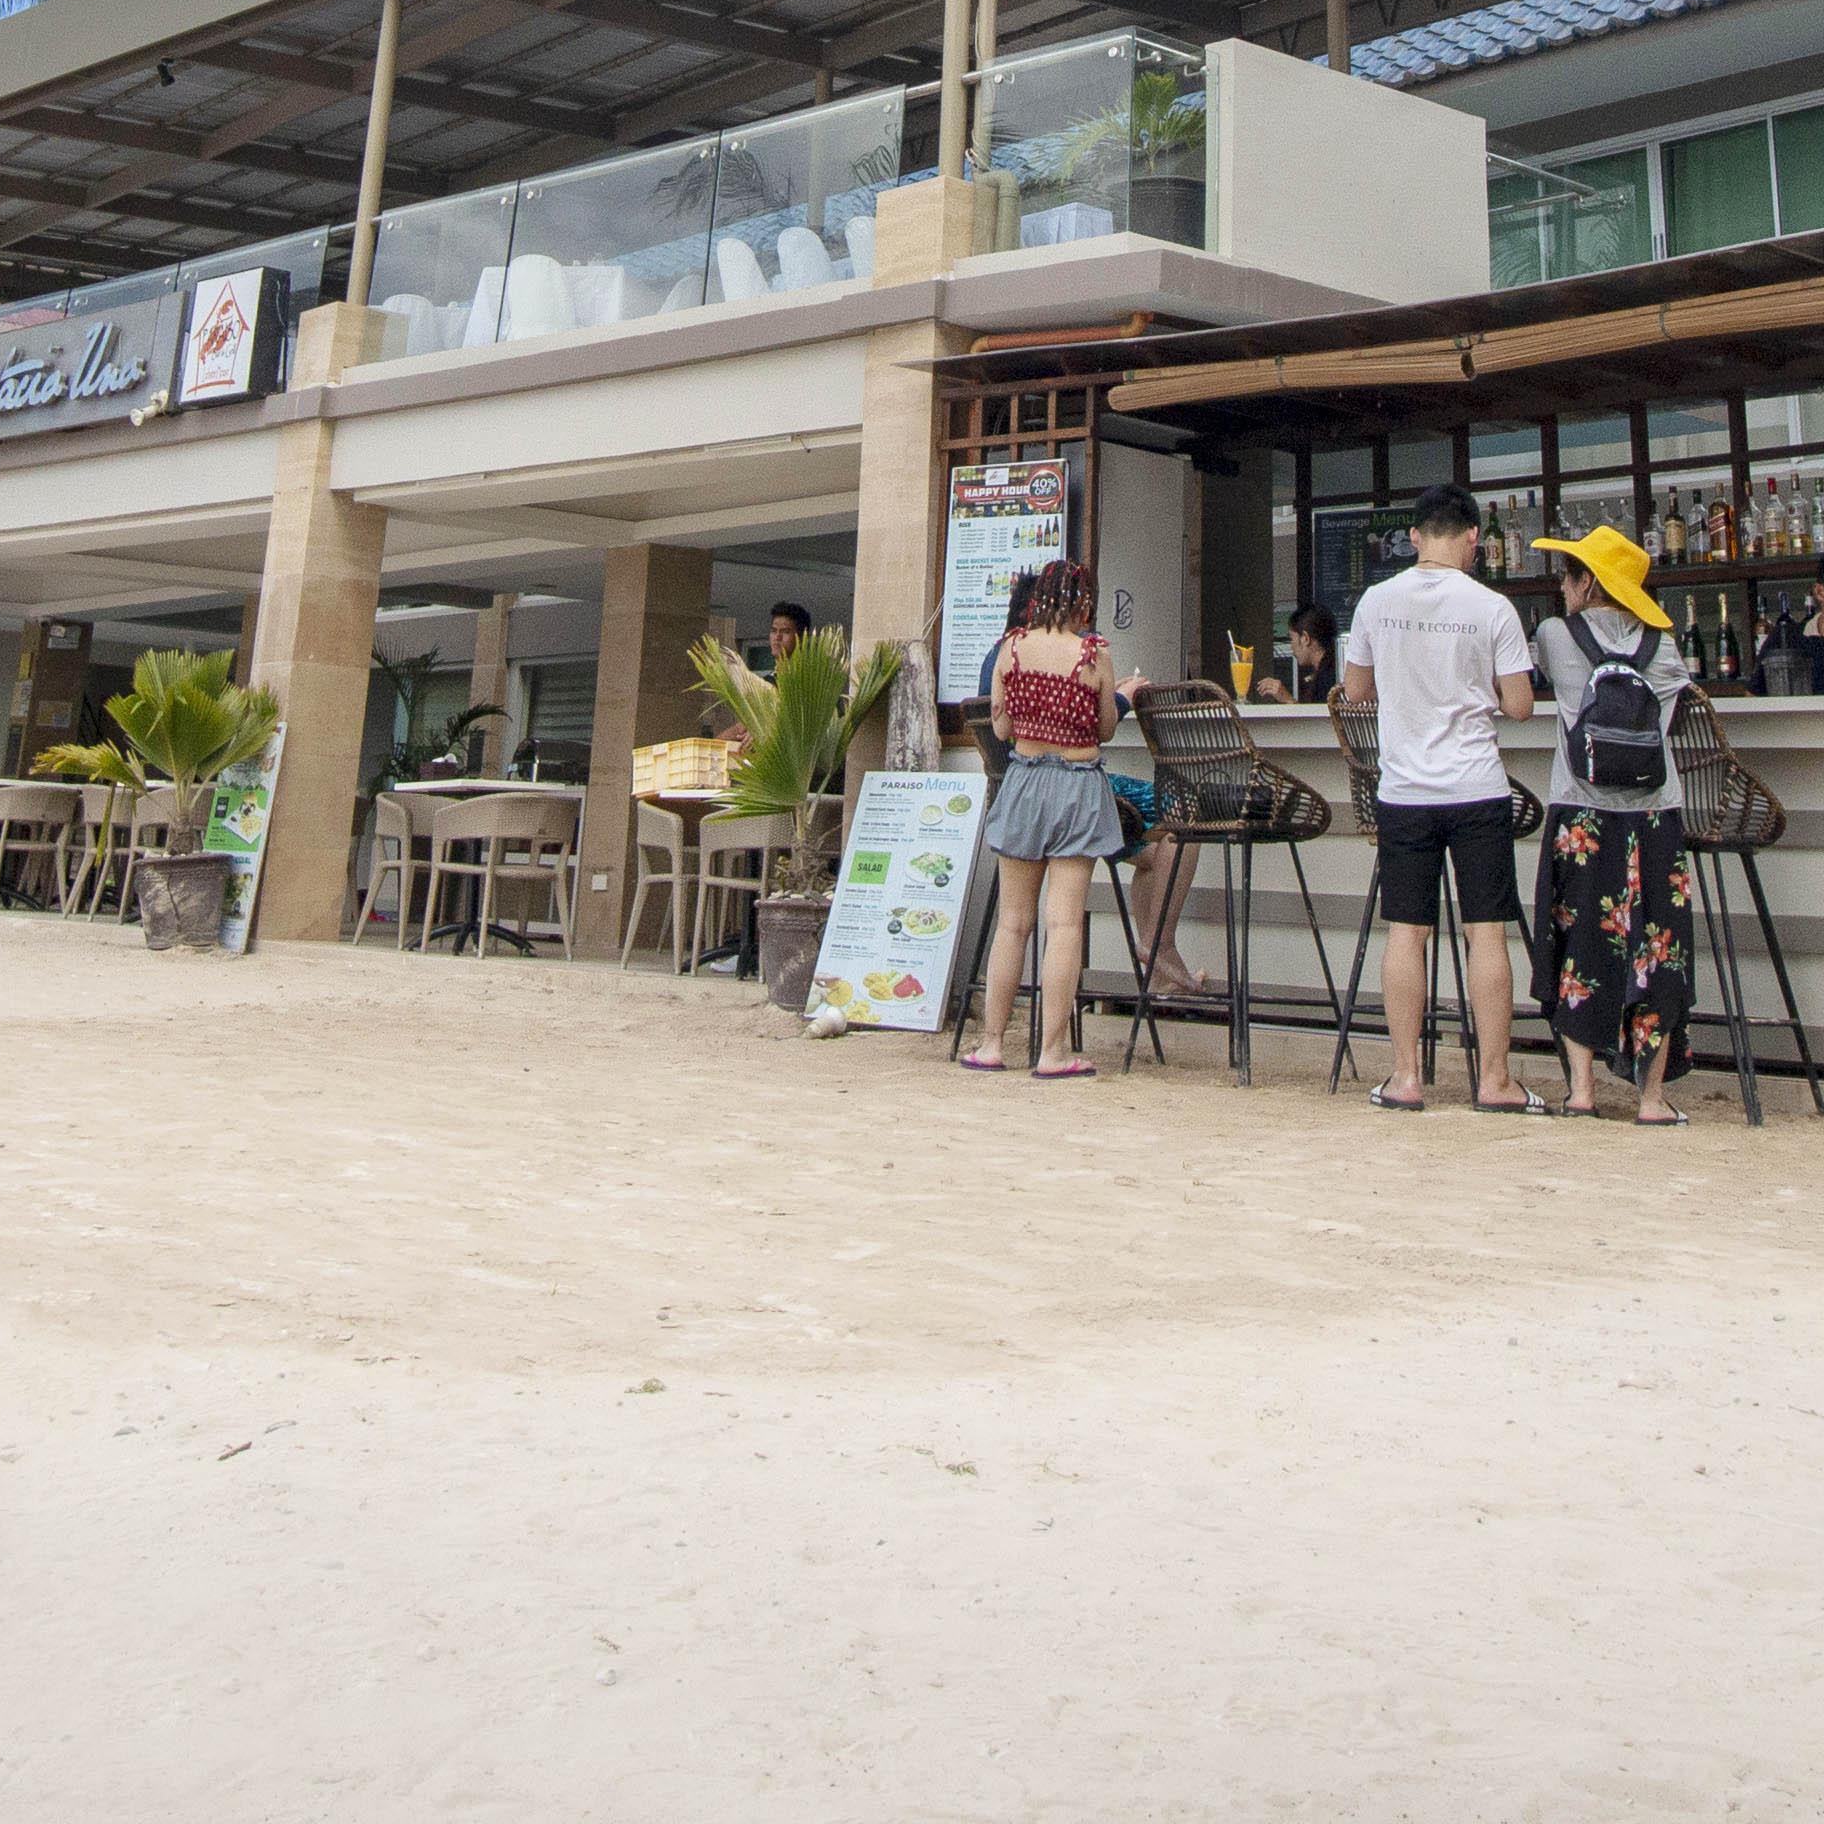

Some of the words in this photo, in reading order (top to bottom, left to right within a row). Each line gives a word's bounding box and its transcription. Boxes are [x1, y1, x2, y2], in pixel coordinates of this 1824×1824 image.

[69, 321, 146, 399] Uno
[1033, 478, 1057, 489] 40%
[964, 487, 1001, 498] HAPPY
[1001, 484, 1031, 496] HOUR
[1034, 487, 1057, 496] OFF
[1321, 517, 1370, 529] Beverage
[1372, 511, 1416, 526] Menu
[1379, 617, 1414, 631] TYLE
[1418, 622, 1479, 635] RECODED
[881, 782, 923, 790] PARAISO
[925, 777, 966, 792] Menu
[856, 862, 883, 873] SALAD
